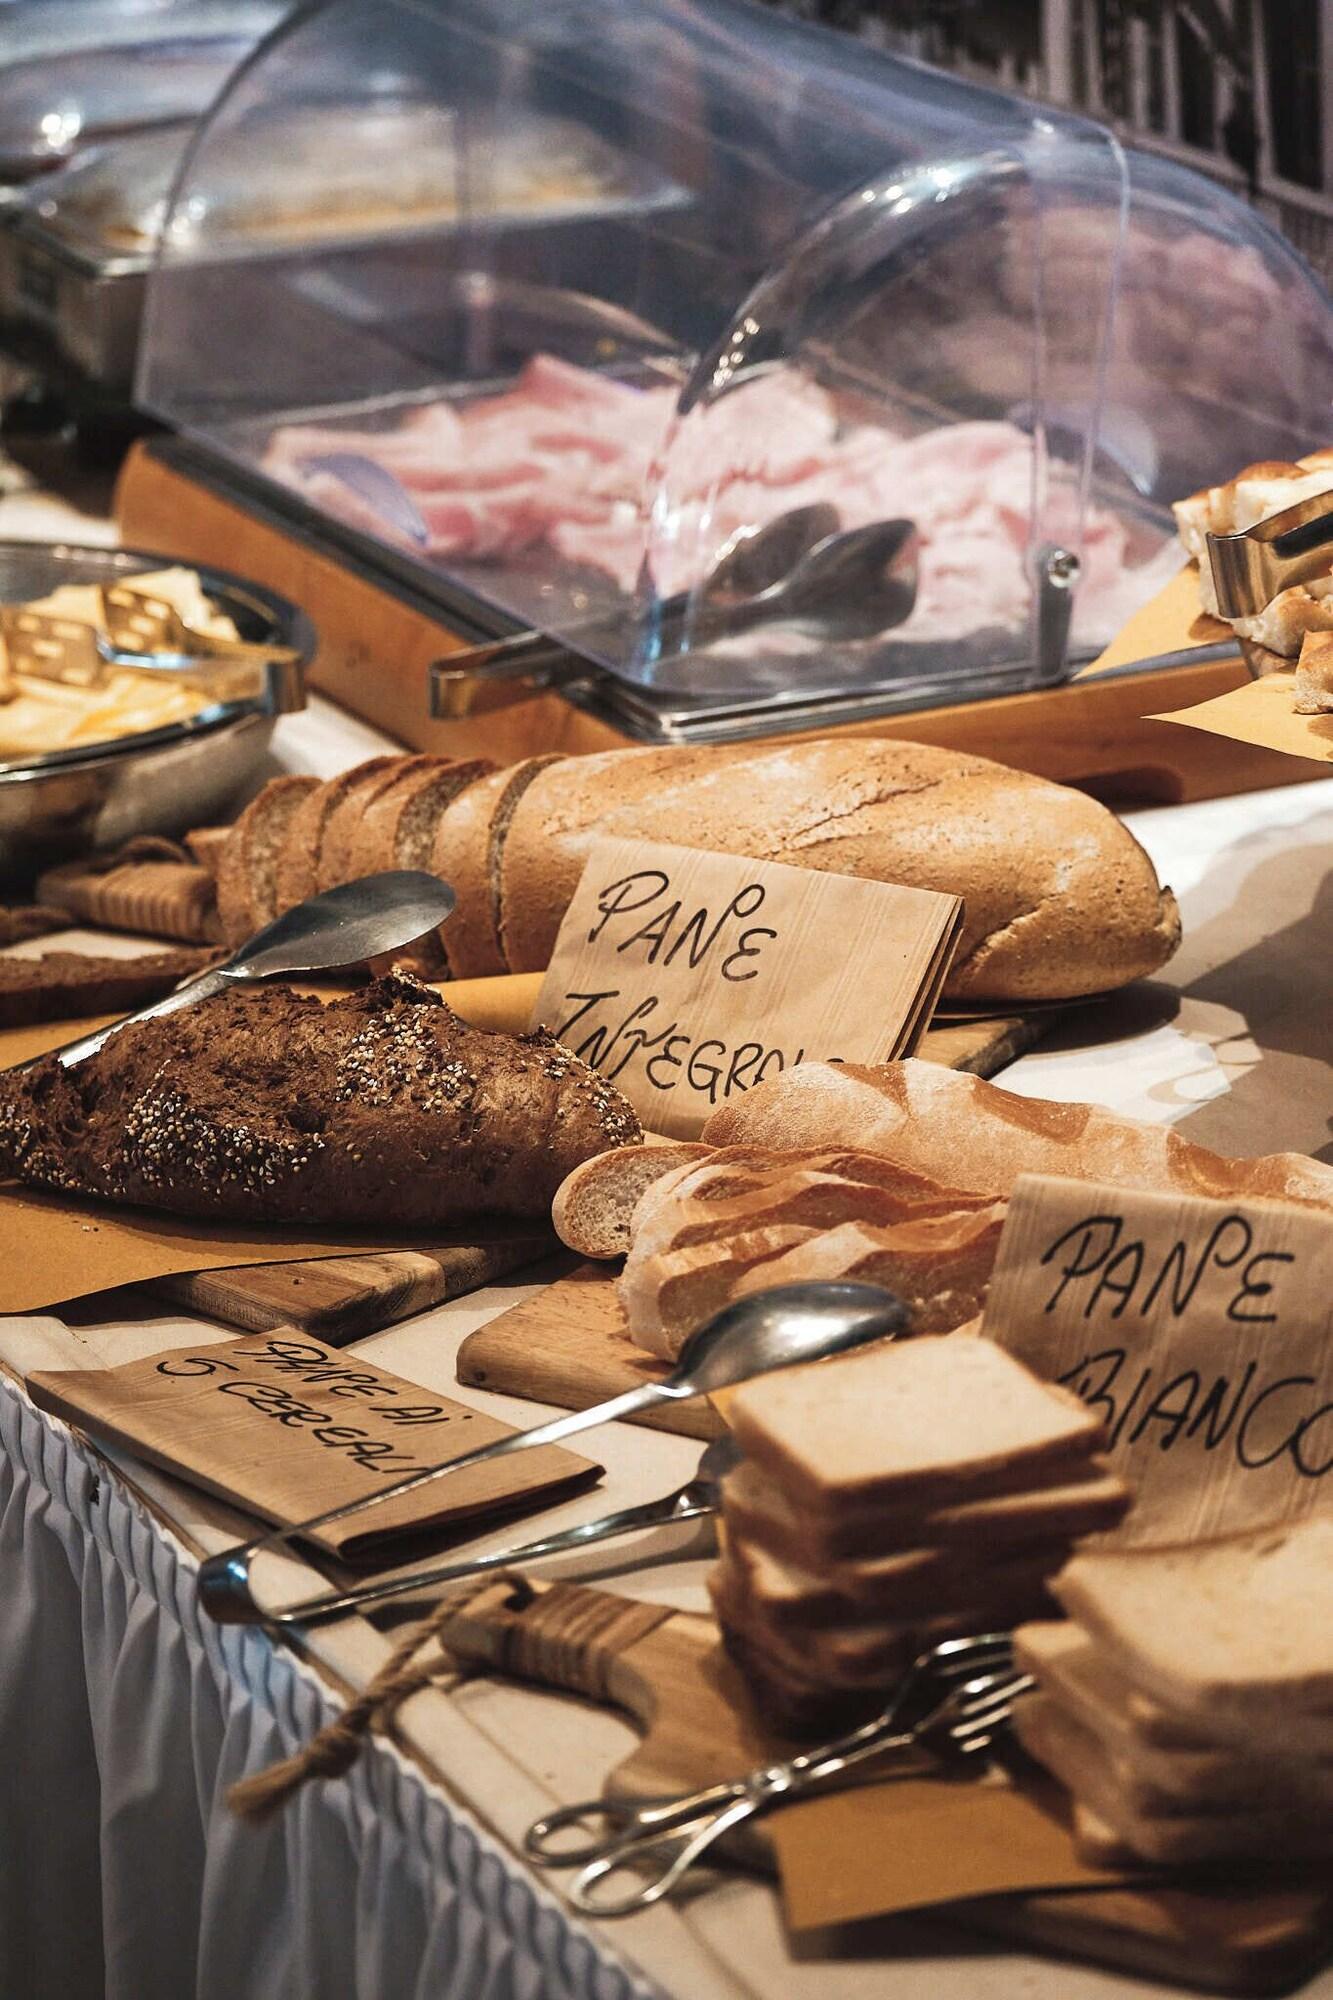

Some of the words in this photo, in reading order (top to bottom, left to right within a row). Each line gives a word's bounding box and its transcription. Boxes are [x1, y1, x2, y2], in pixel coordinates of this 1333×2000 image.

[588, 870, 778, 982] PANE
[1041, 1215, 1295, 1323] PANE
[156, 1358, 240, 1377] 5
[233, 1341, 398, 1398] PANE
